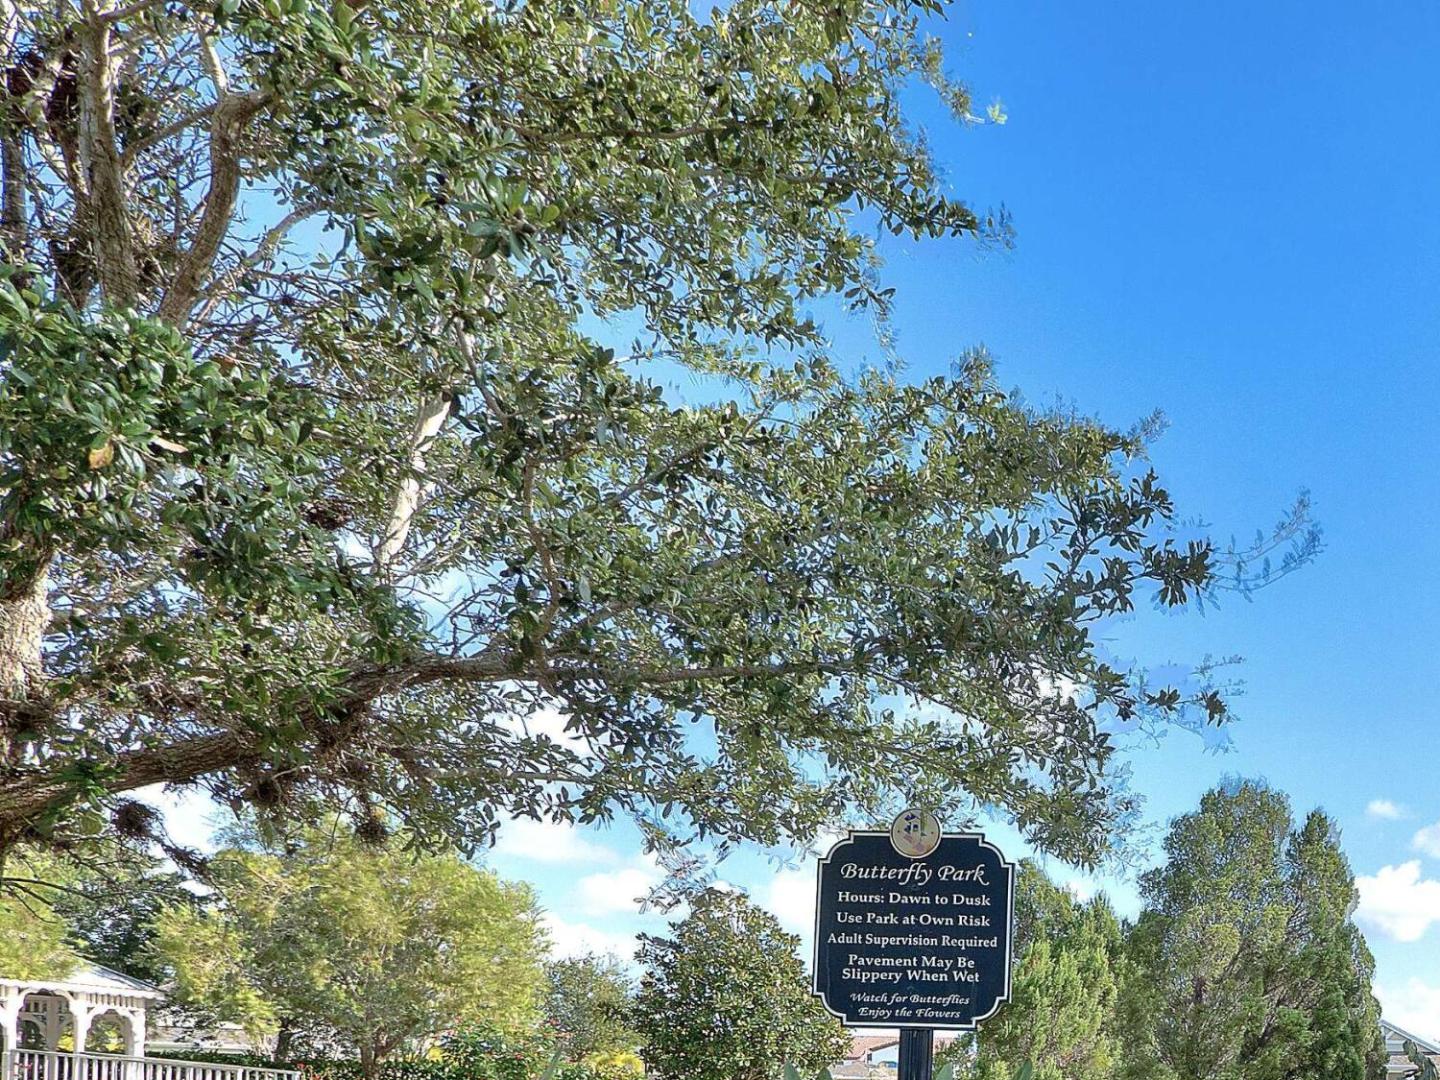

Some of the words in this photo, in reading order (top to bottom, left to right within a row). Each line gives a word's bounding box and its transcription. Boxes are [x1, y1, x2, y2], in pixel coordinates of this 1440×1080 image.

[841, 863, 932, 885] Butterfly
[938, 864, 989, 885] Park
[838, 892, 884, 903] Hours:
[889, 893, 930, 904] Dawn
[935, 894, 947, 905] to
[953, 895, 990, 906] Dusk
[837, 913, 862, 924] Use
[867, 914, 898, 924] Park
[903, 915, 916, 925] at
[919, 914, 953, 925] Own
[958, 915, 990, 926] Risk
[828, 934, 862, 944] Adult
[865, 935, 938, 948] Supervision
[942, 936, 997, 948] Required
[849, 955, 917, 966] Pavement
[922, 956, 953, 971] May
[958, 957, 975, 968] Be
[842, 969, 902, 983] Slippery
[907, 970, 948, 982] When
[953, 971, 979, 982] Wet
[850, 993, 887, 1003] Watch
[887, 994, 908, 1005] for
[910, 994, 970, 1005] Butterflies
[858, 1007, 892, 1020] Enjoy
[895, 1008, 912, 1017] the
[916, 1009, 960, 1018] Flowers
